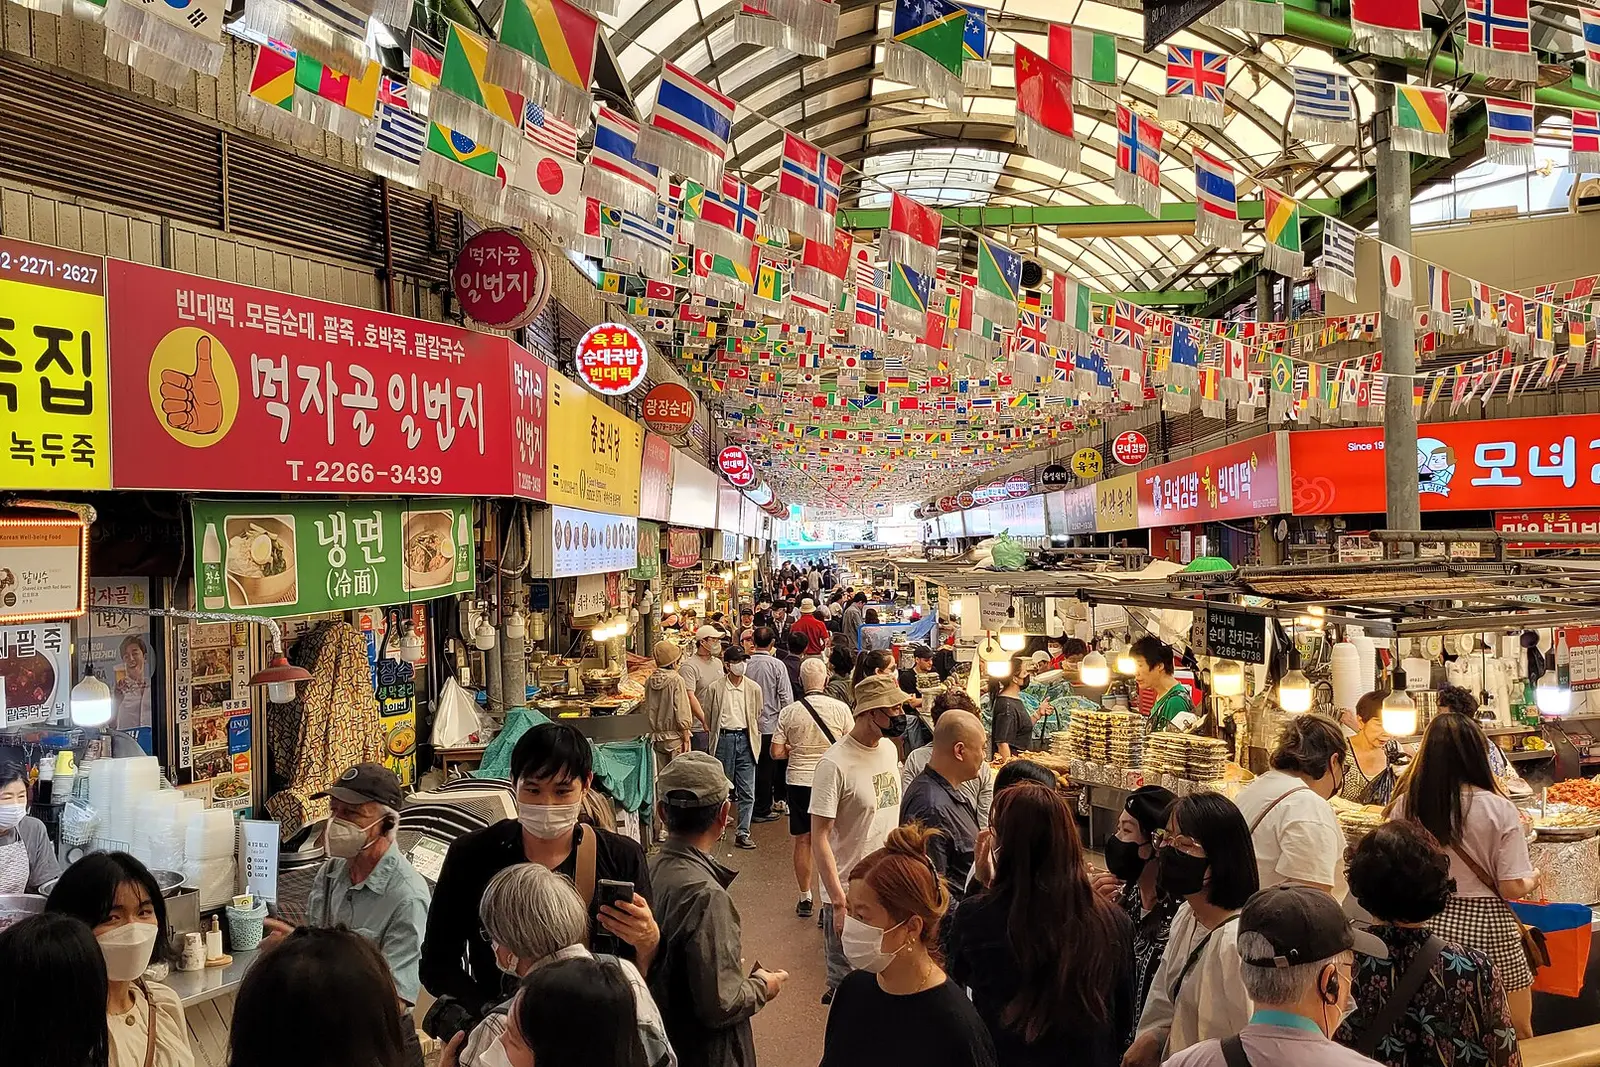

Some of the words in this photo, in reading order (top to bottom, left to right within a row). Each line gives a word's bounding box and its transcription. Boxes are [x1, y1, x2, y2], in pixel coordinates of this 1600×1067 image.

[469, 245, 521, 266] 먹자골
[460, 271, 528, 303] 일번지
[592, 332, 628, 348] 육회
[583, 349, 639, 367] 순대국밥
[590, 366, 632, 382] 빈대떡
[646, 398, 692, 418] 광장순대
[590, 414, 620, 463] 종로식당
[1347, 442, 1371, 452] Since
[1373, 440, 1385, 451] 19
[9, 431, 96, 468] 녹두죽
[1116, 443, 1147, 454] 모녀김밥
[1471, 435, 1600, 490] 모녀
[286, 460, 443, 486] T.2266-3439
[1218, 459, 1251, 504] 빈대떡
[1542, 512, 1571, 523] 원조
[313, 510, 386, 568] 냉면
[21, 570, 49, 585] 팥빙수
[1210, 613, 1236, 627] 하니네
[1194, 626, 1205, 637] 64
[1209, 626, 1226, 643] 순대
[1228, 629, 1263, 649] 잔치국수
[1215, 645, 1261, 662] 2268-6738
[380, 657, 414, 686] 장수
[377, 682, 415, 700] 생막걸리
[229, 718, 249, 730] CESCO
